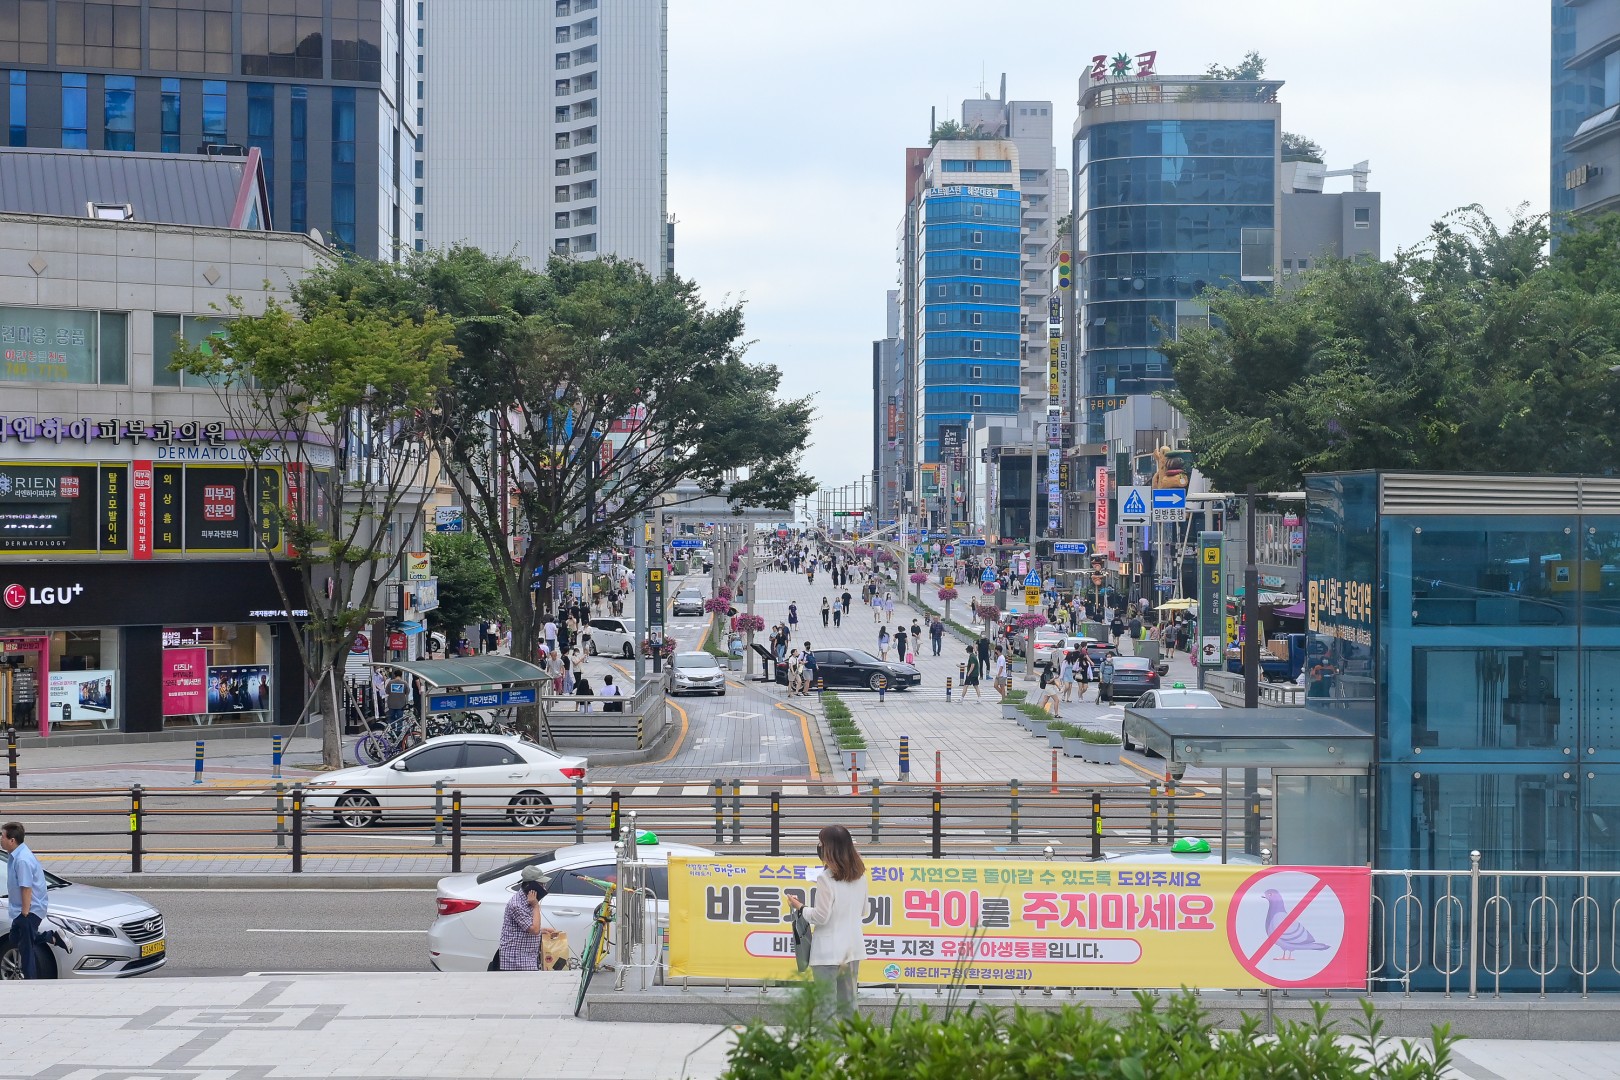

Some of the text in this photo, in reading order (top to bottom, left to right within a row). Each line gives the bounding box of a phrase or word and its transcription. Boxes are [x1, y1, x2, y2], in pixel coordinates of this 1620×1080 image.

[15, 477, 56, 488] RIEN
[204, 487, 235, 502] 피부과
[204, 504, 235, 518] 전문의
[1098, 499, 1106, 527] PIZZA
[1154, 508, 1184, 520] 일방통행
[201, 530, 239, 539] 피부과전문의
[1211, 570, 1219, 584] 5
[655, 583, 661, 592] 3
[1319, 578, 1372, 623] 도시철도 해운대역
[709, 863, 746, 877] 해운대
[871, 867, 905, 882] 찾아
[910, 867, 978, 883] 자연으로
[984, 868, 1034, 884] 돌아갈
[1040, 869, 1055, 885] 수
[1062, 869, 1111, 885] 있도록
[1117, 871, 1201, 887] 도와주세요
[904, 889, 1010, 928] 먹이를
[1022, 892, 1214, 931] 주지마세요
[864, 939, 1104, 959] 경부 지정 유해 야생동물입니다.
[904, 967, 1033, 980] 해운대구청(환경위생과)
